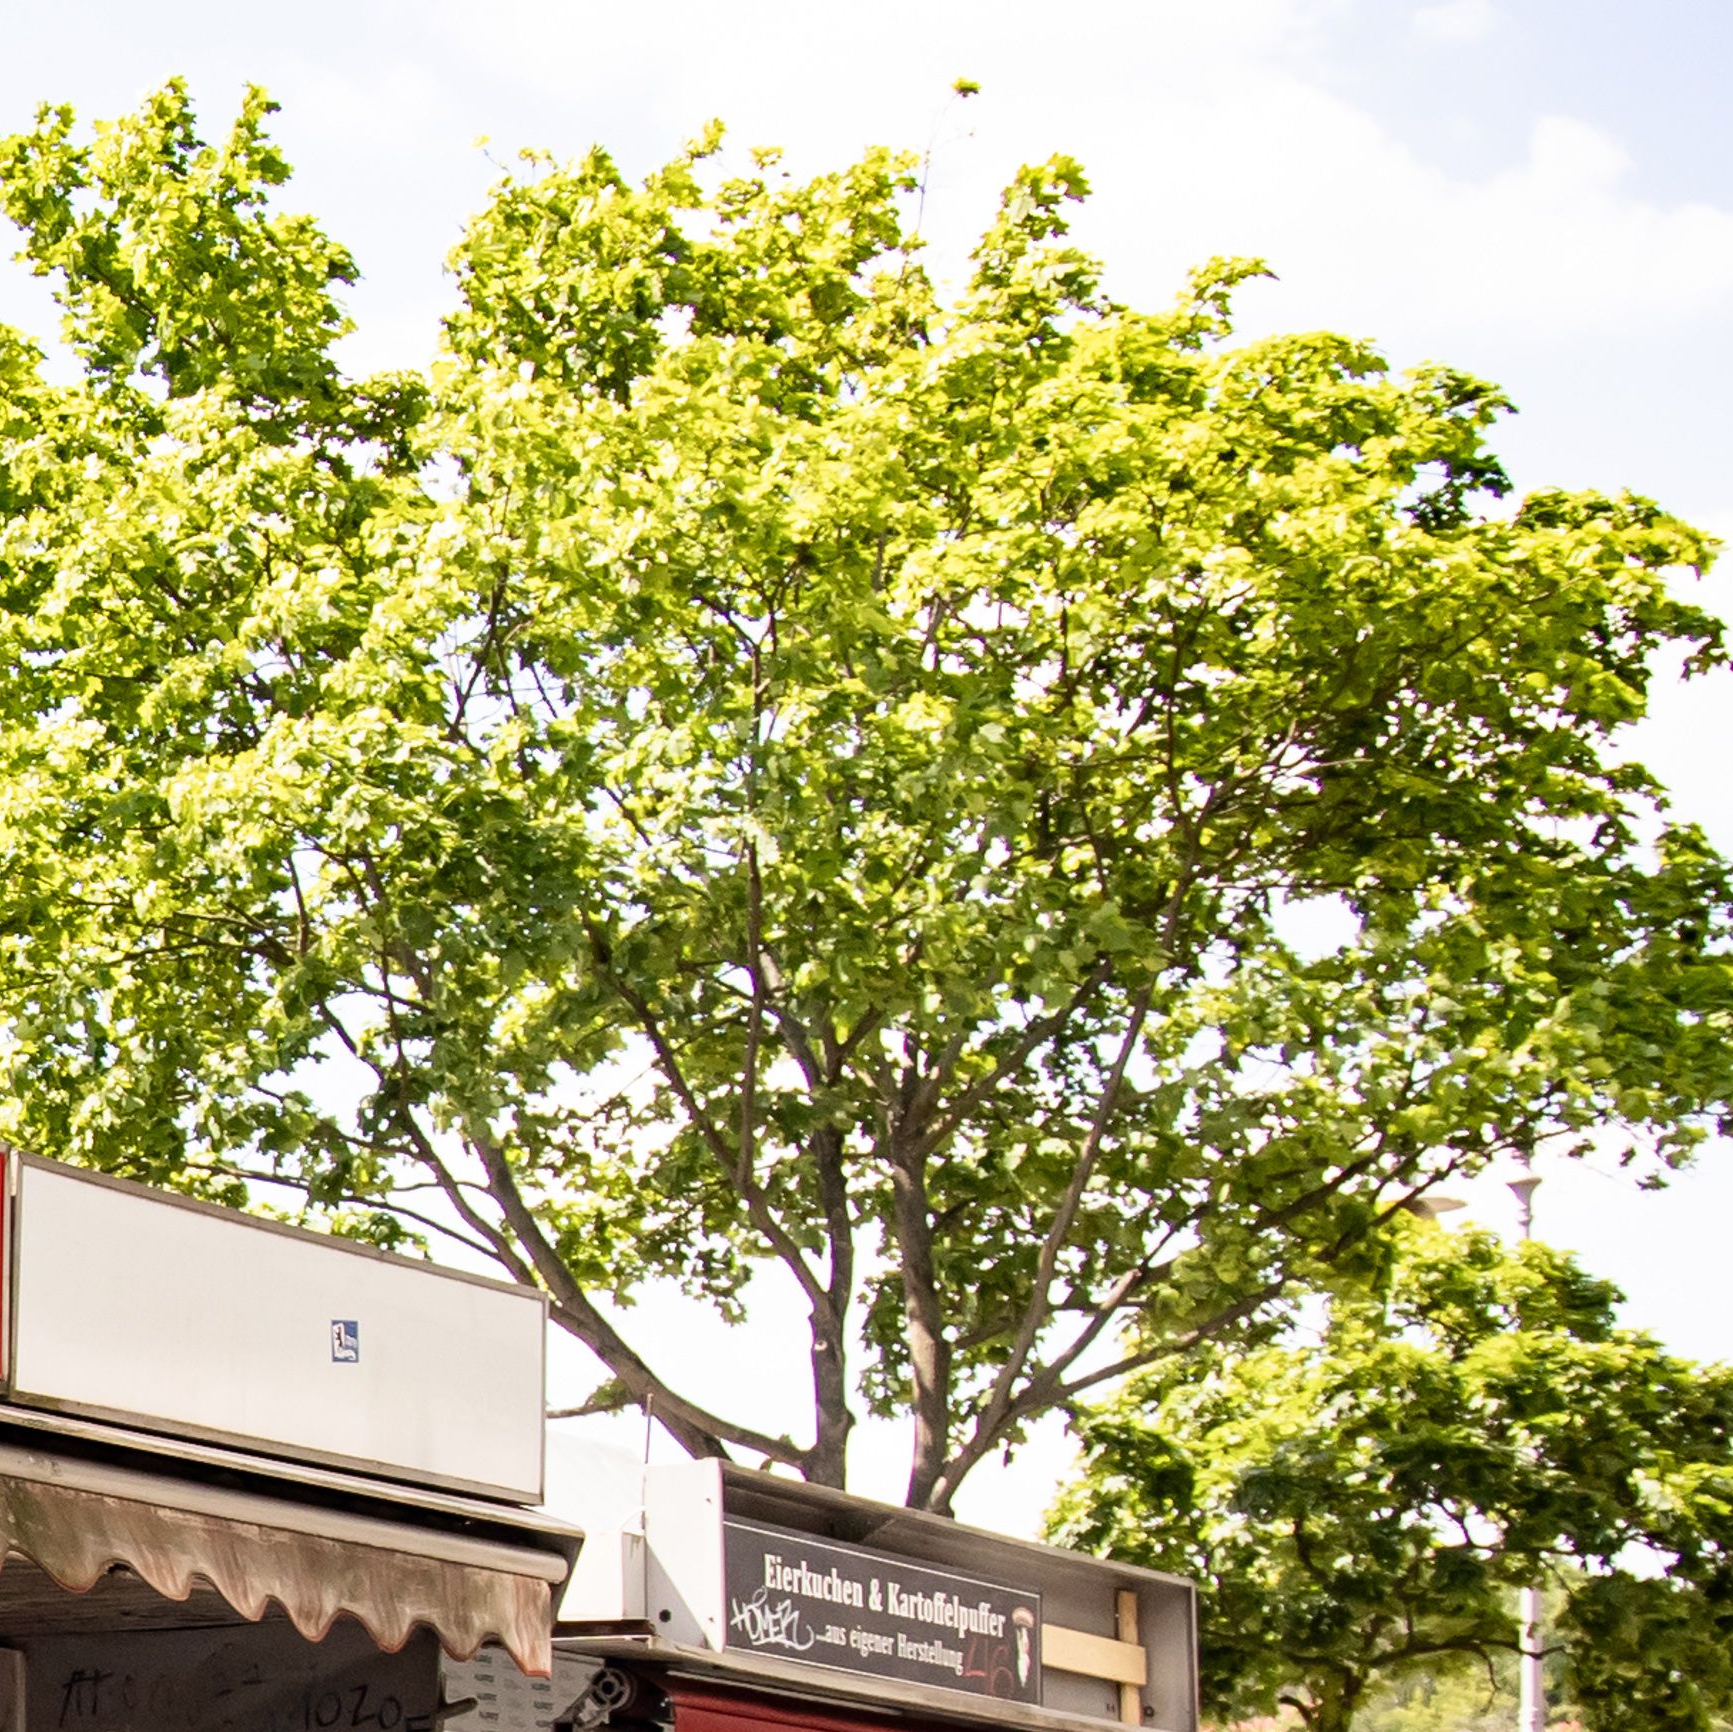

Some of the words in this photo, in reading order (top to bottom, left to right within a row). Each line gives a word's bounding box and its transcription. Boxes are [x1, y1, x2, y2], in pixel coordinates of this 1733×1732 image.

[763, 1551, 865, 1610] Eierkuchen
[868, 1578, 884, 1611] &
[886, 1581, 1007, 1641] Kartoffelpuffer
[850, 1626, 895, 1657] eigener
[896, 1633, 966, 1676] Herstellung
